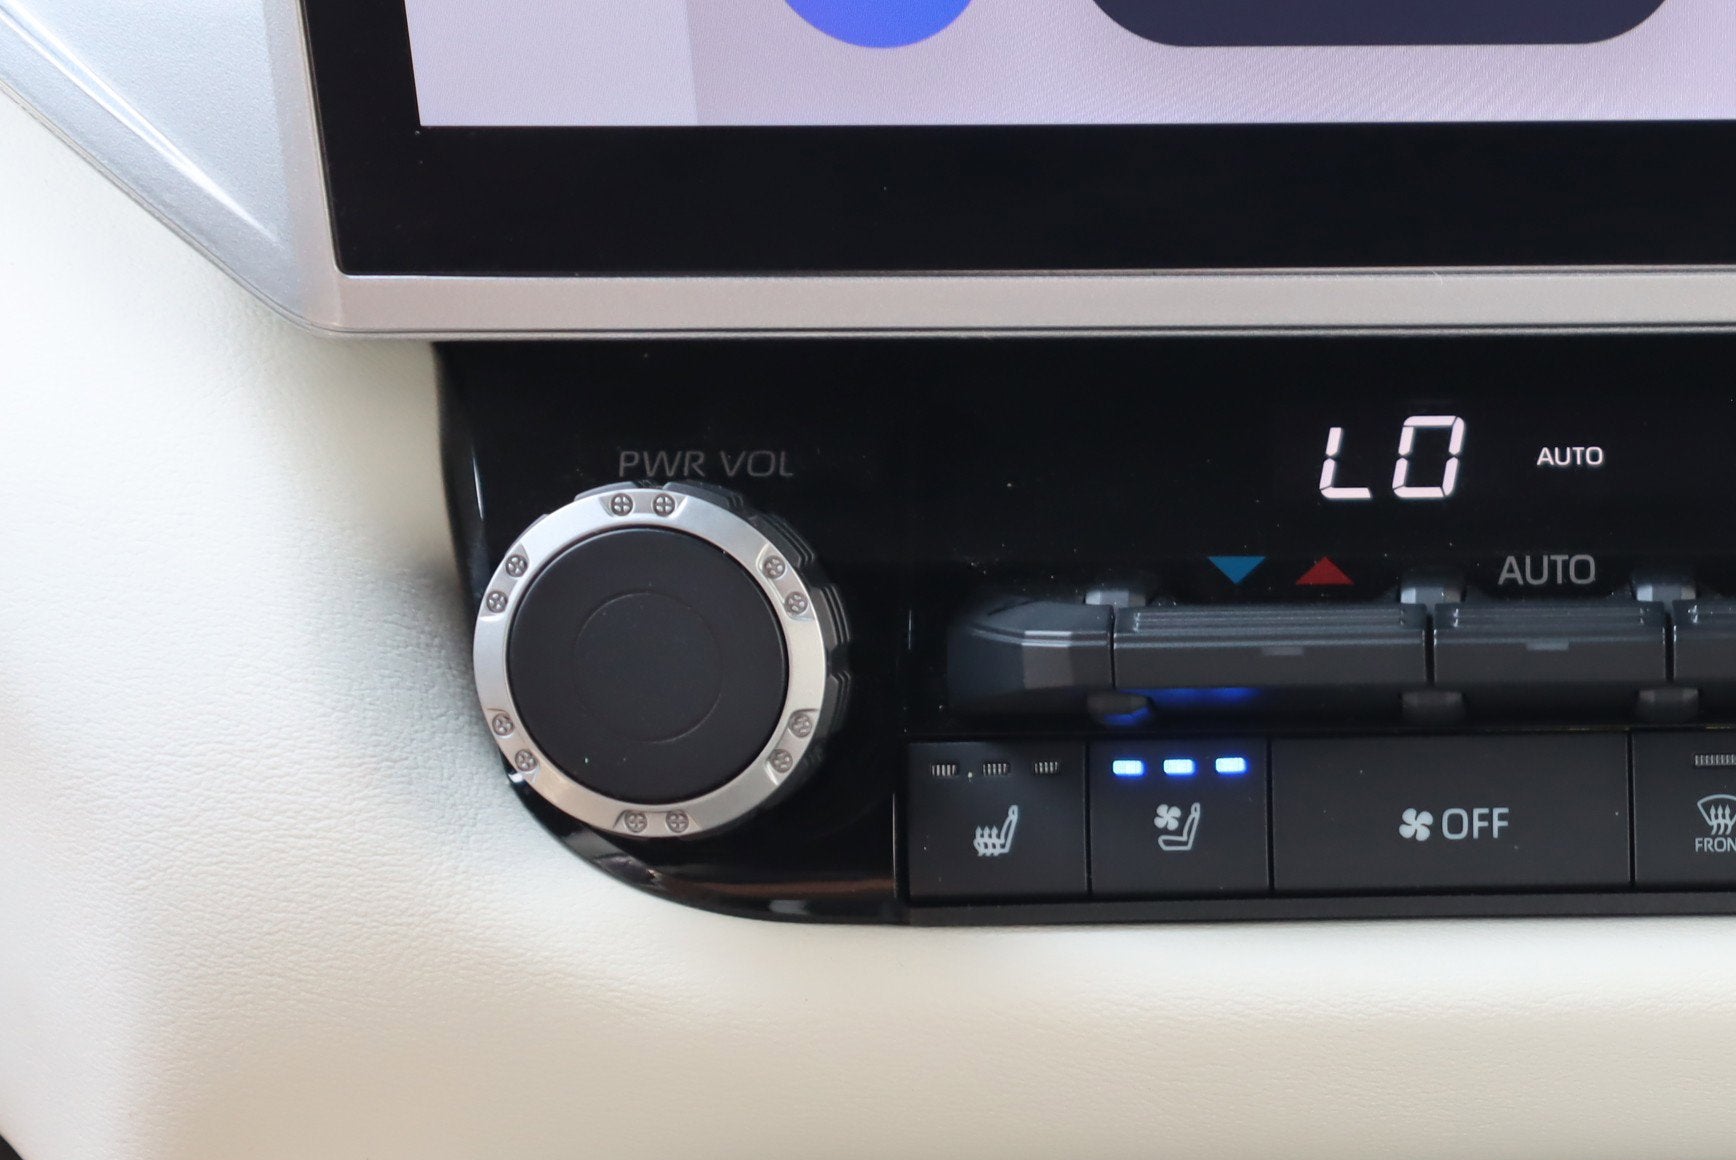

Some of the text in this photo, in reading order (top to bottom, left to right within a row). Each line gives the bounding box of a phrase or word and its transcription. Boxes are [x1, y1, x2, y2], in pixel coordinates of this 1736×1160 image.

[617, 450, 794, 478] PWR VOL
[1536, 446, 1605, 468] AUTO
[1497, 554, 1597, 586] AUTO
[1441, 807, 1511, 840] OFF
